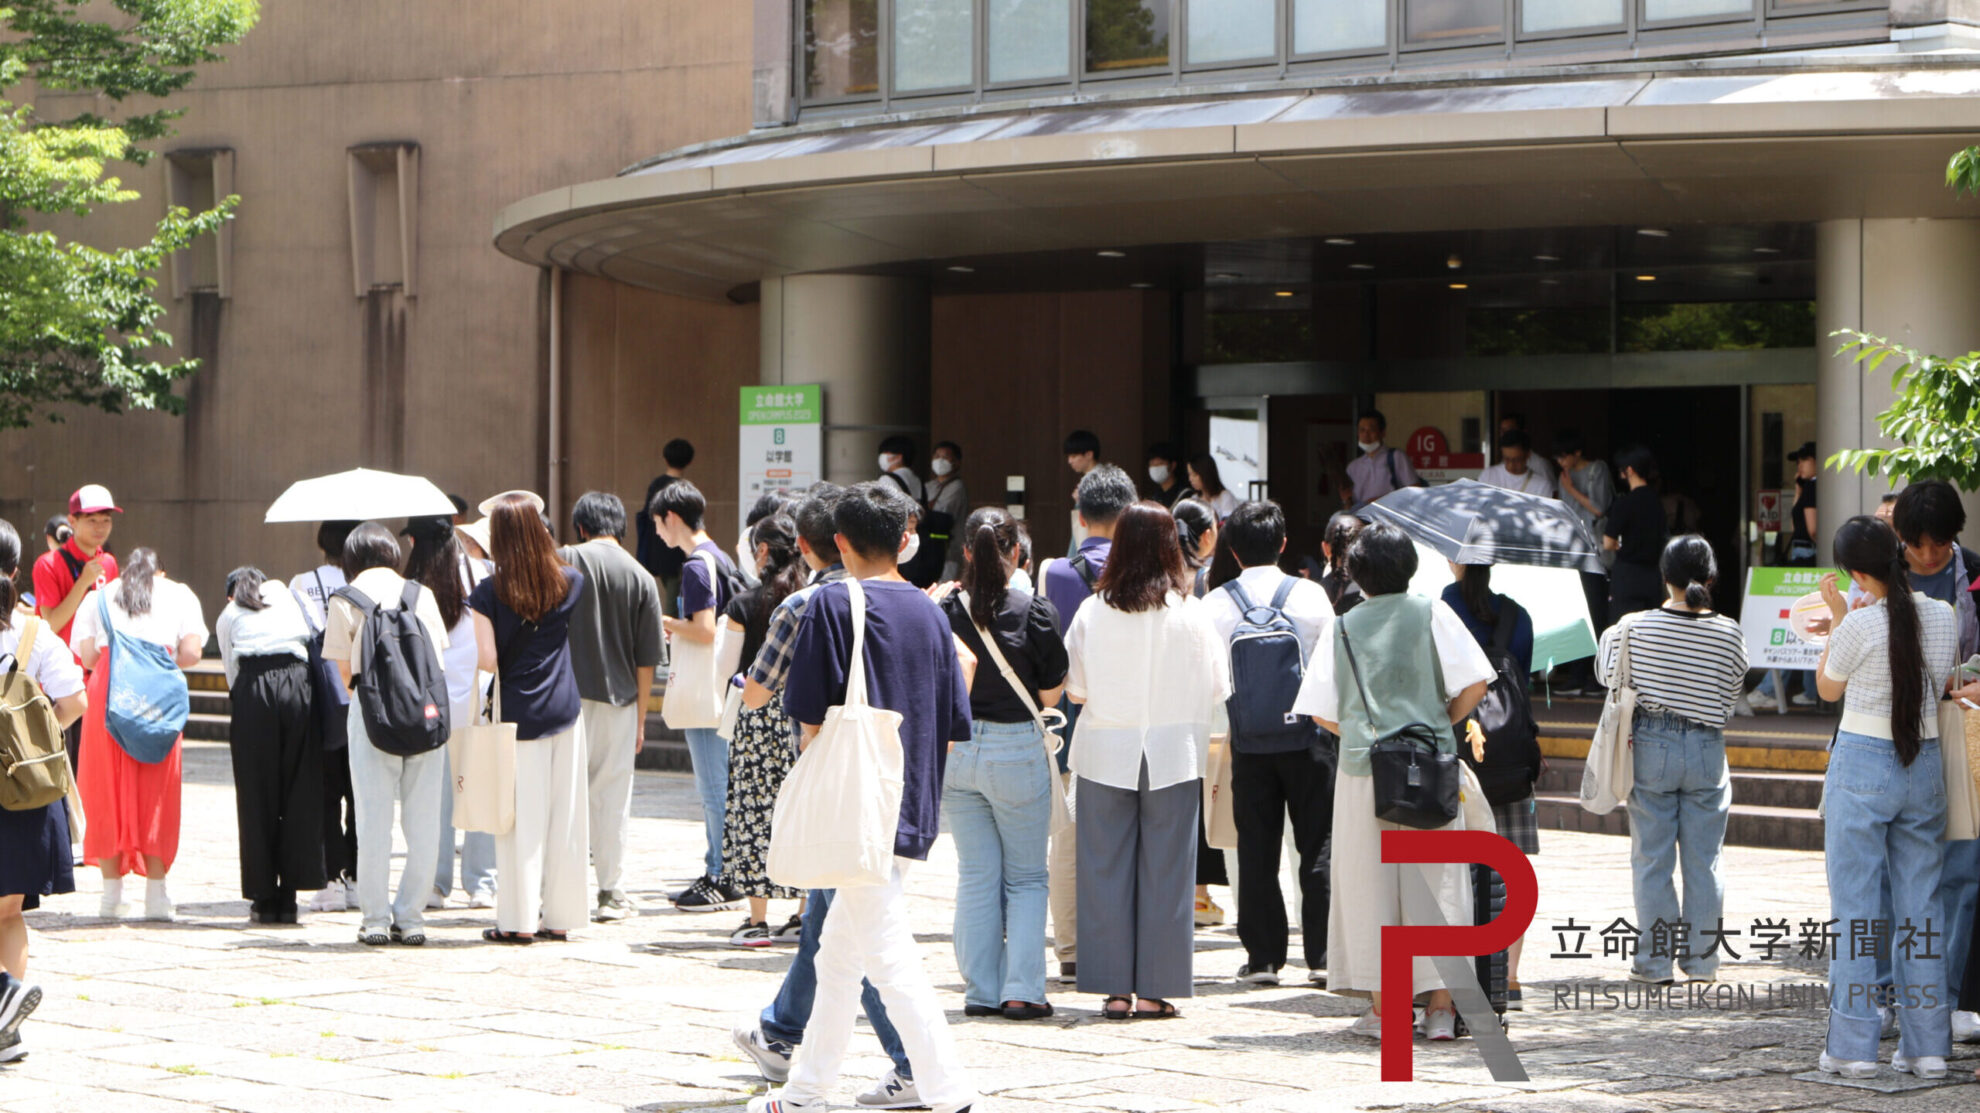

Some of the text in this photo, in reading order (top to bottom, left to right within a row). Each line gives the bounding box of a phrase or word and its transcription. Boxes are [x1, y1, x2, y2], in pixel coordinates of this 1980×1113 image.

[755, 392, 804, 408] 立命館大学
[775, 430, 783, 443] 8
[1417, 435, 1435, 452] IG
[1782, 572, 1822, 585] 立命館大
[1773, 631, 1783, 644] 8
[886, 1079, 903, 1096] N
